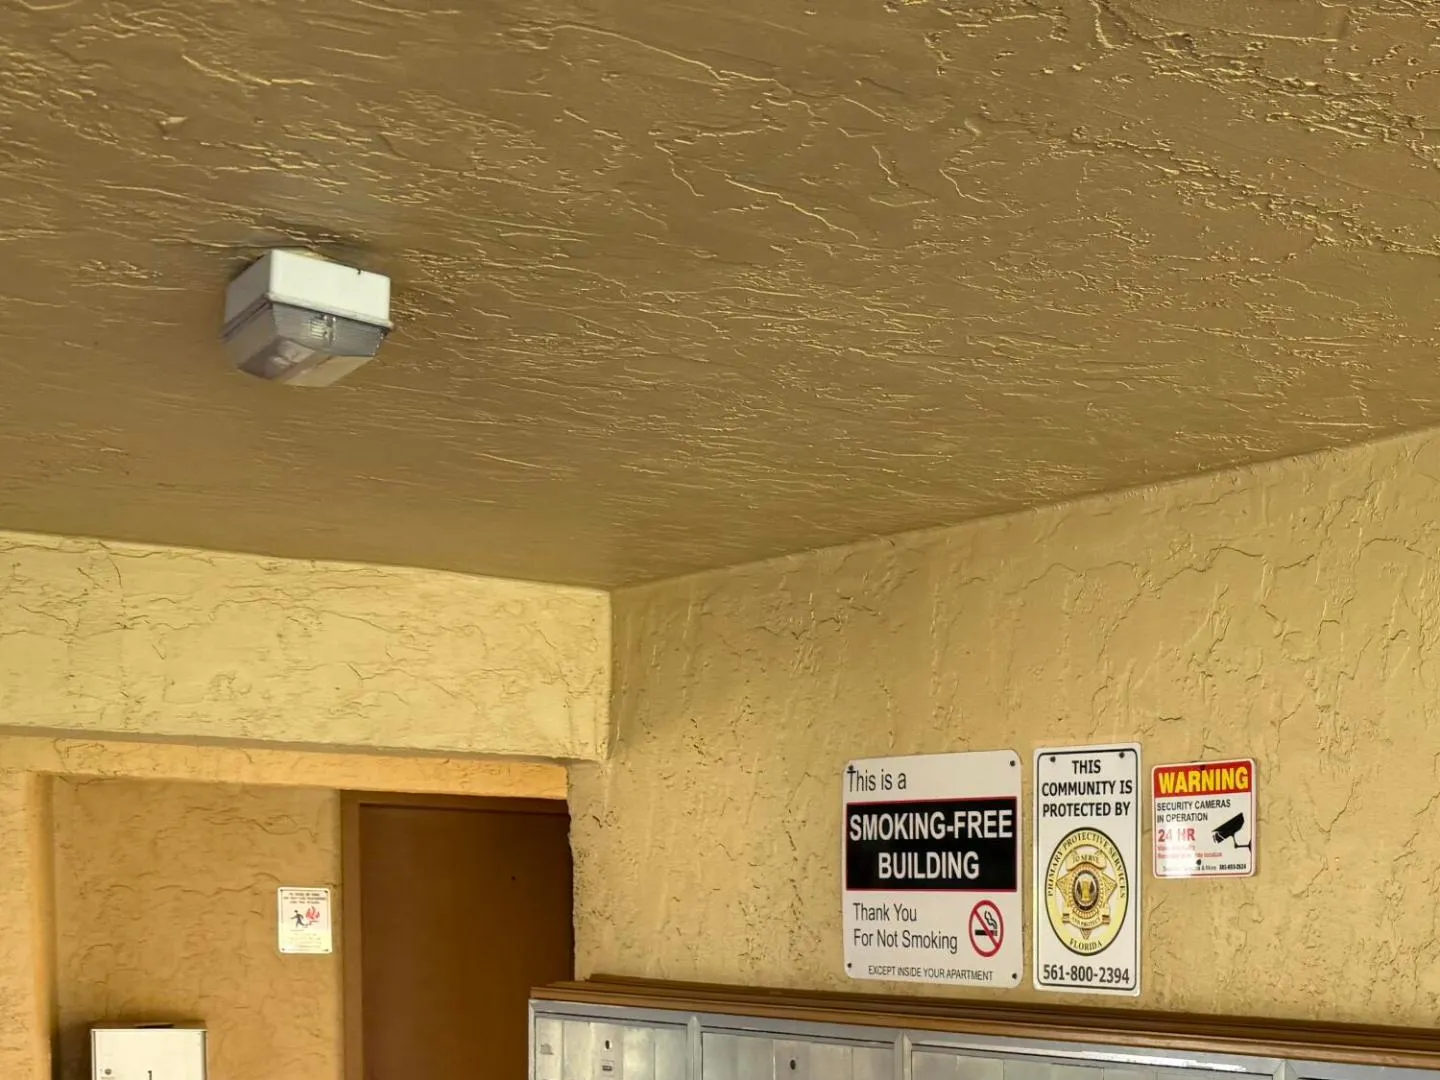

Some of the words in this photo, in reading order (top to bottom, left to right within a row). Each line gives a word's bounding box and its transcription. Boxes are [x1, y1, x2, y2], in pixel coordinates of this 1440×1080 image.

[1072, 759, 1101, 774] THIS
[847, 769, 876, 792] This
[881, 769, 893, 790] is
[897, 772, 907, 790] a
[1042, 780, 1116, 796] COMMUNITY
[1119, 780, 1133, 795] IS
[1159, 767, 1249, 794] WARNING
[1043, 802, 1111, 817] PROTECTED
[1114, 801, 1131, 816] BY
[1156, 801, 1193, 811] SECURITY
[1194, 799, 1231, 809] CAMERAS
[850, 810, 1013, 841] SMOKING-FREE
[1156, 814, 1164, 823] IN
[1165, 812, 1208, 823] OPERATION
[1063, 832, 1110, 850] PROTECTIVE
[878, 851, 980, 879] BUILDING
[853, 902, 890, 921] Thank
[893, 903, 917, 922] You
[853, 929, 873, 947] For
[877, 929, 898, 948] Not
[902, 930, 958, 954] Smoking
[1070, 938, 1103, 951] FLORIDA
[868, 965, 896, 976] EXCEPT
[898, 967, 921, 977] INSIDE
[923, 969, 945, 979] YOUR
[947, 969, 993, 981] APARTMENT
[1043, 964, 1130, 984] 561-800-2394
